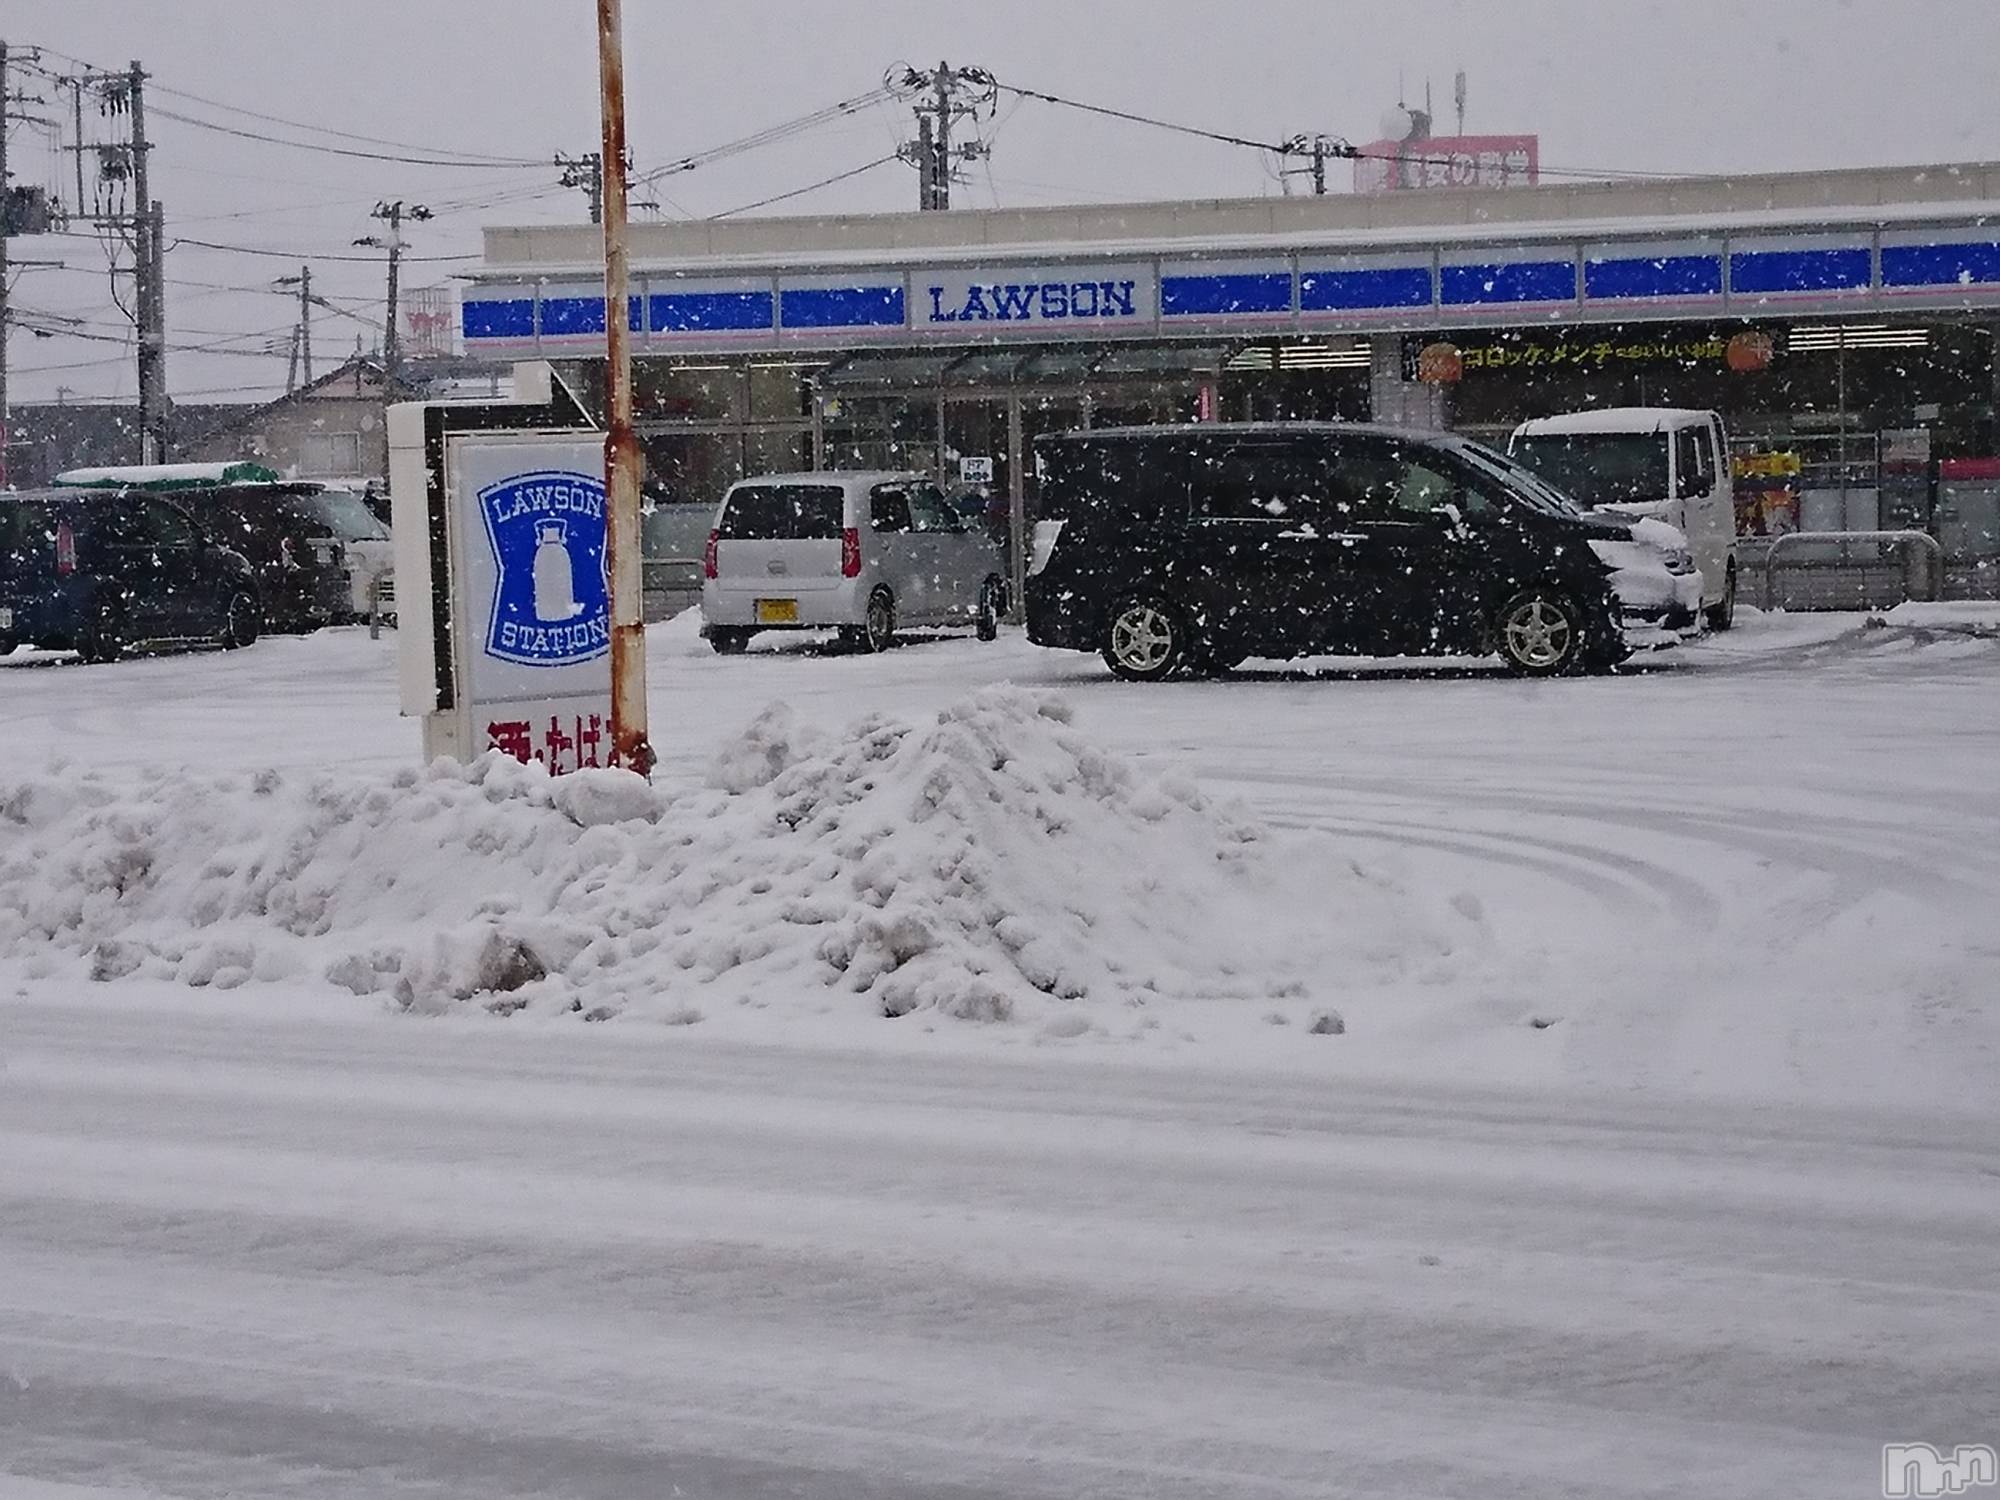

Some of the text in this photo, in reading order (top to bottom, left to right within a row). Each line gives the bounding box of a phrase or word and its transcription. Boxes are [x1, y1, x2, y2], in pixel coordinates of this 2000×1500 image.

[928, 280, 1136, 322] LAWSON
[492, 485, 604, 523] LAWSON
[501, 615, 611, 652] STATION
